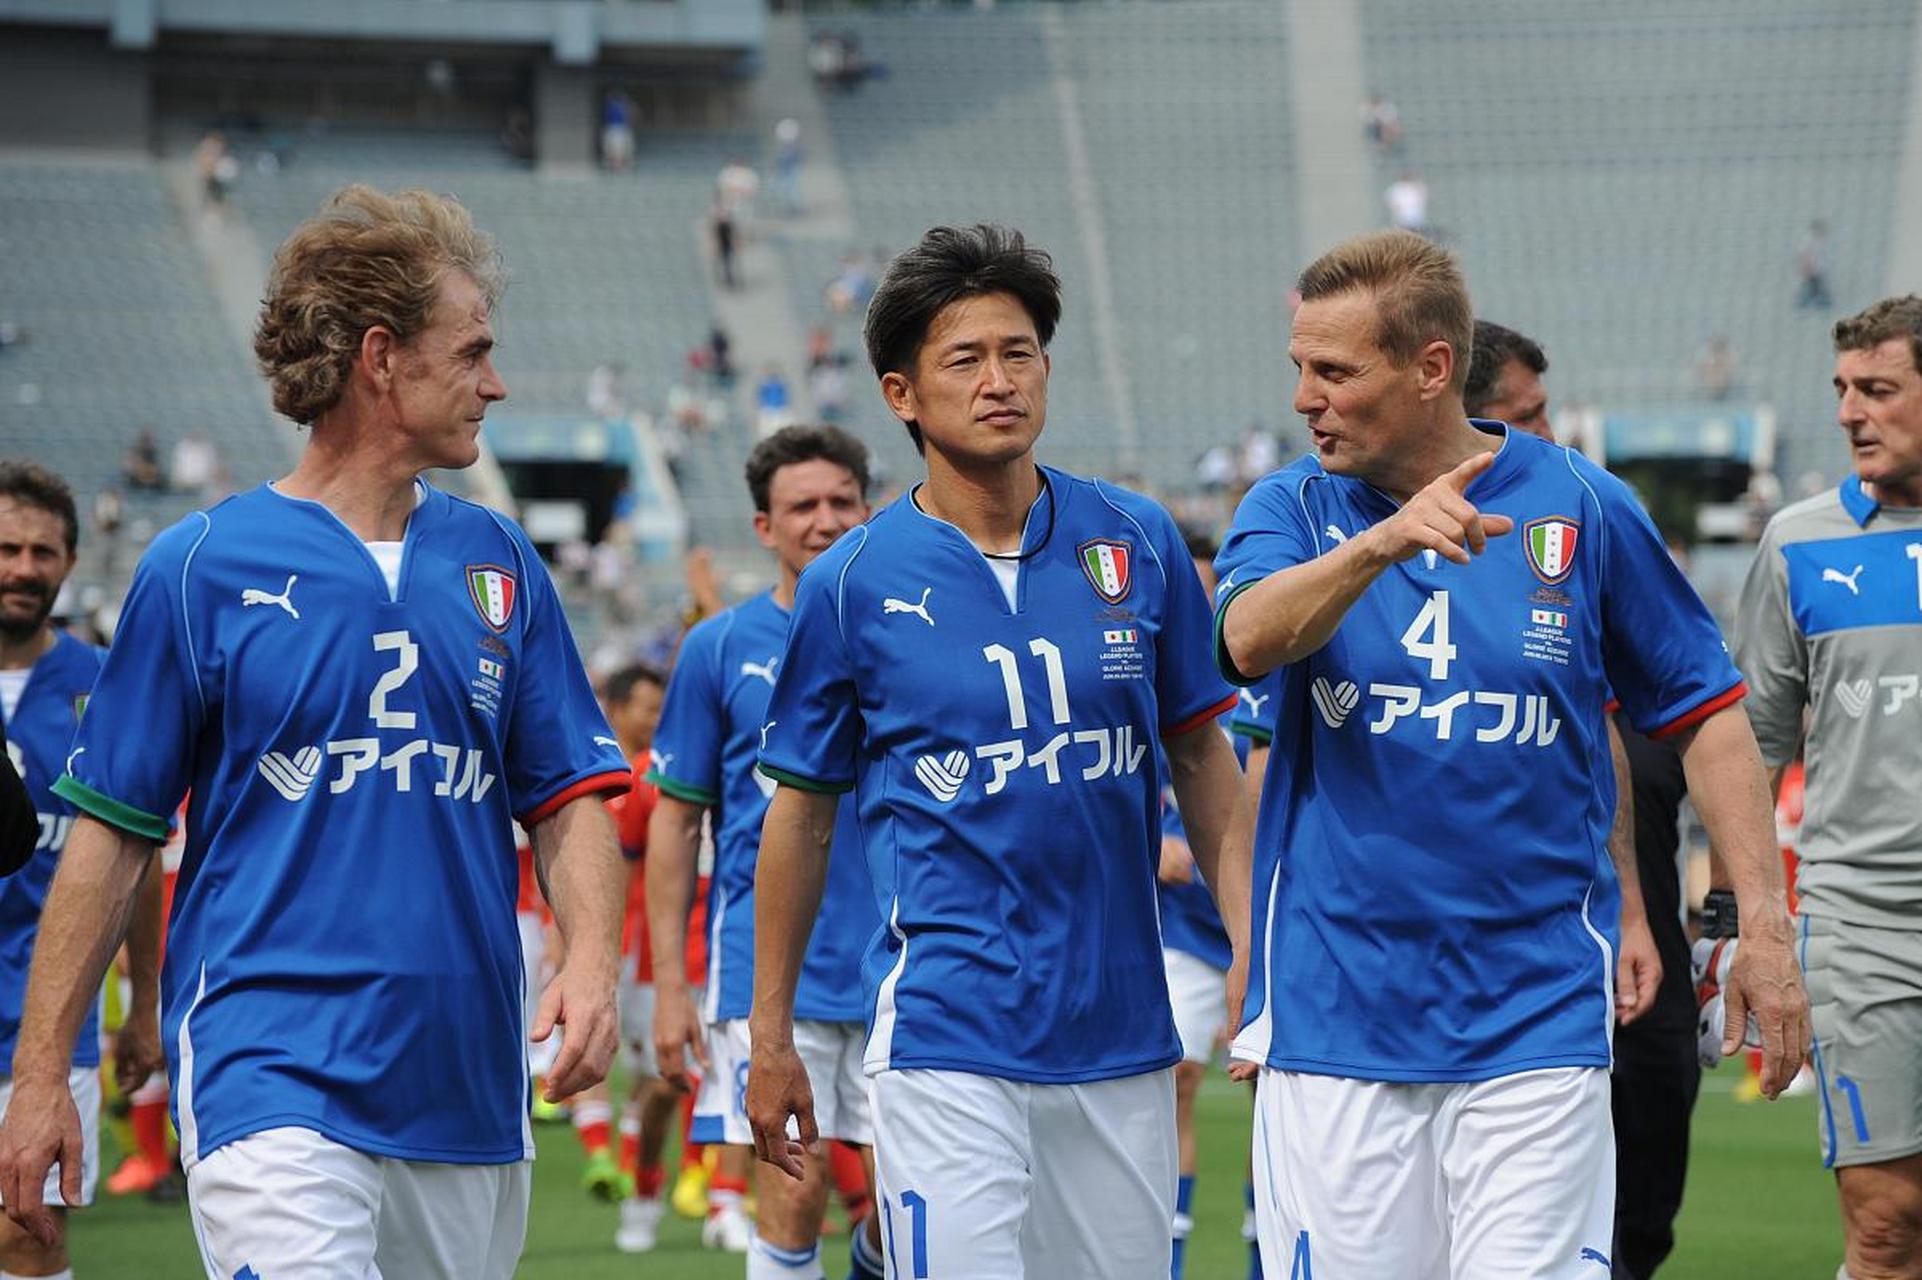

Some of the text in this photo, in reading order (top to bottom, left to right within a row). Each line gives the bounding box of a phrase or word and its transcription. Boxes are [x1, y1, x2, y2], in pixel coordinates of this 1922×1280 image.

[1400, 590, 1457, 680] 4
[368, 630, 419, 729] 2
[983, 637, 1071, 730] 11
[1878, 675, 1922, 716] ア
[1369, 683, 1561, 747] アイフル
[327, 738, 496, 803] アイフル
[975, 725, 1147, 795] アイフル
[1836, 1076, 1870, 1142] 1
